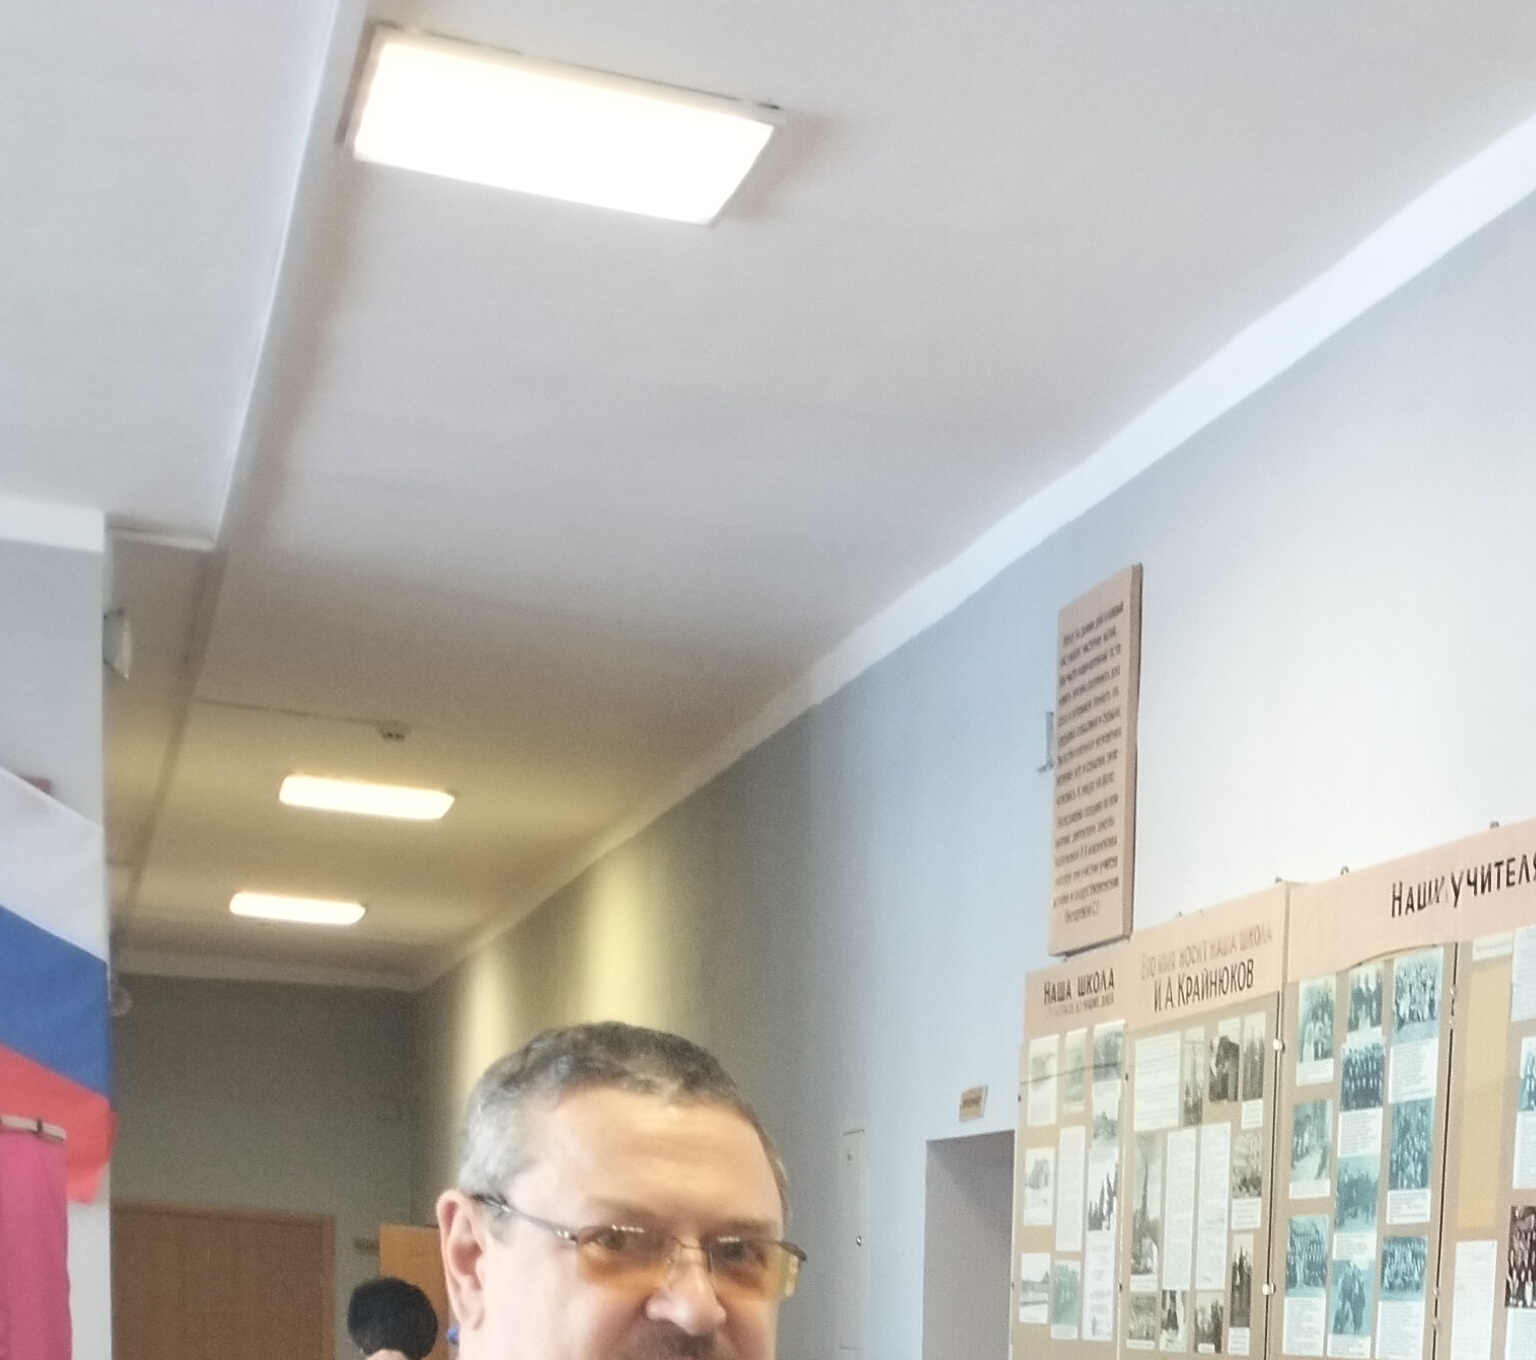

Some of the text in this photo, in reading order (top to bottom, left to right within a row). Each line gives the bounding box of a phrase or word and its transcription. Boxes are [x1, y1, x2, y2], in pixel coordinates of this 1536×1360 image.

[1044, 979, 1072, 1006] НАША
[1077, 967, 1115, 997] ШКОЛА
[1178, 958, 1255, 1007] КРАЙНЮКОВ
